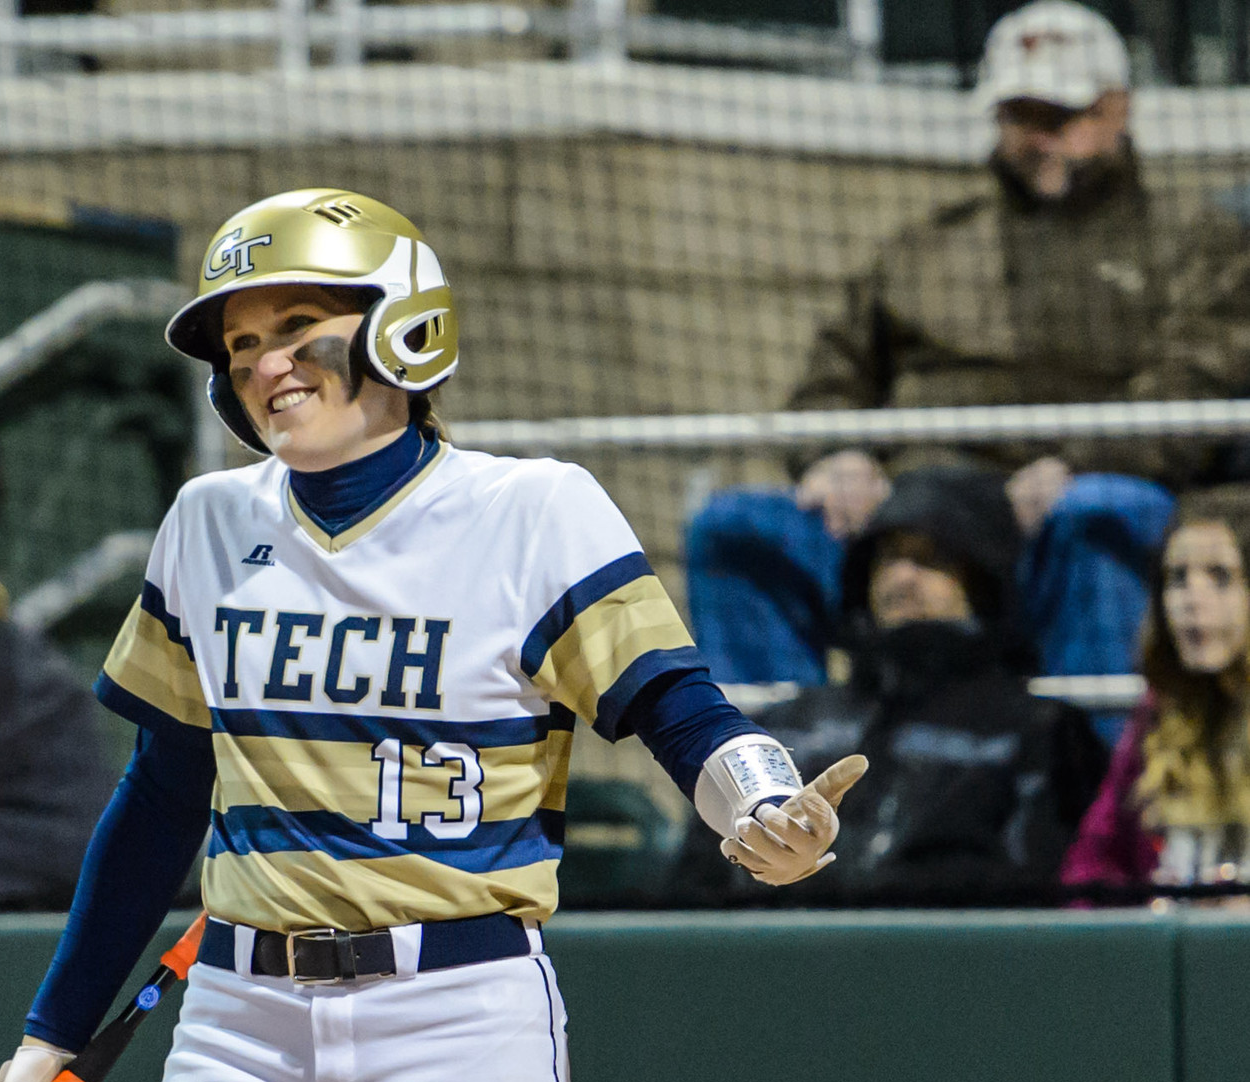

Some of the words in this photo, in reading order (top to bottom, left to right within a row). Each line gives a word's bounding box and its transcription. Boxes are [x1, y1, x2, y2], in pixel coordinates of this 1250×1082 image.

[204, 227, 272, 280] GT
[213, 604, 453, 712] TECH
[369, 738, 484, 840] 13
